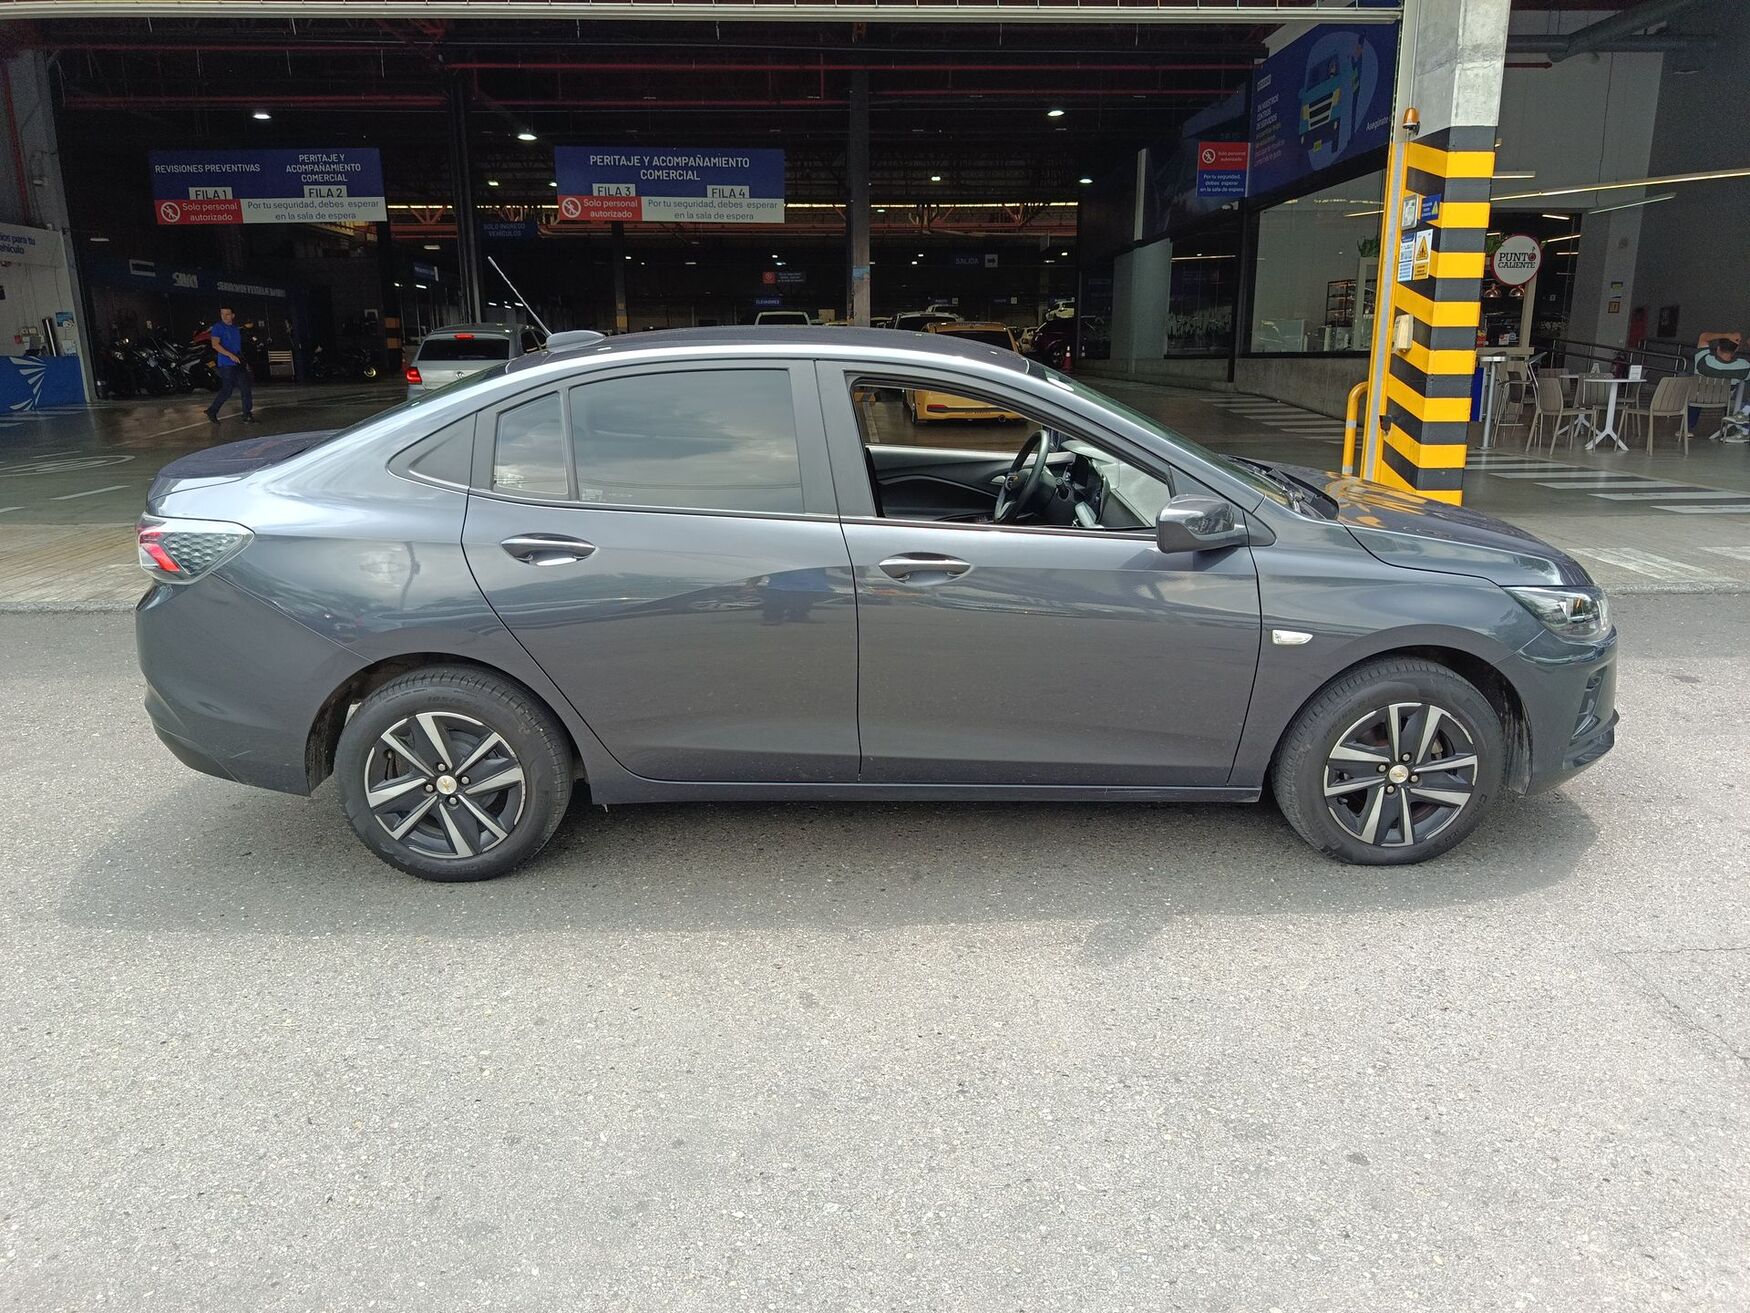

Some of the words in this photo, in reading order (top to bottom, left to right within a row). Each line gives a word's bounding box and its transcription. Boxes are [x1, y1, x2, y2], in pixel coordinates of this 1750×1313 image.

[299, 154, 338, 163] PERITAJE
[339, 154, 345, 162] Y
[589, 155, 641, 166] PERITAJE
[643, 155, 650, 166] Y
[652, 154, 750, 168] ACOMPAÑAMIENTO
[155, 164, 204, 173] REVISIONES
[204, 163, 261, 173] PREVENTIVAS
[286, 163, 361, 173] ACOMPAÑAMIENTO
[301, 174, 348, 182] COMERCIAL
[640, 169, 701, 181] COMERCIAL
[195, 190, 221, 200] FILA
[223, 190, 227, 200] 1
[309, 188, 335, 198] FILA
[336, 188, 343, 198] 2
[597, 186, 623, 196] FILA
[625, 186, 631, 196] 3
[711, 188, 737, 198] FILA
[738, 188, 745, 198] 4
[182, 203, 201, 211] Solo
[202, 202, 238, 212] personal
[248, 201, 261, 209] Por
[318, 200, 344, 208] debes
[347, 200, 379, 210] esperar
[583, 199, 602, 207] Solo
[603, 199, 638, 209] personal
[648, 199, 662, 208] Por
[718, 199, 743, 208] debes
[747, 201, 778, 210] esperar
[190, 213, 233, 221] autorizado
[288, 212, 295, 220] la
[297, 212, 314, 220] sala
[315, 211, 327, 219] de
[328, 212, 357, 221] espera
[590, 210, 633, 218] autorizado
[687, 211, 694, 219] la
[695, 211, 712, 220] sala
[714, 211, 725, 220] de
[726, 212, 754, 221] espera
[1498, 252, 1537, 262] PUNTO
